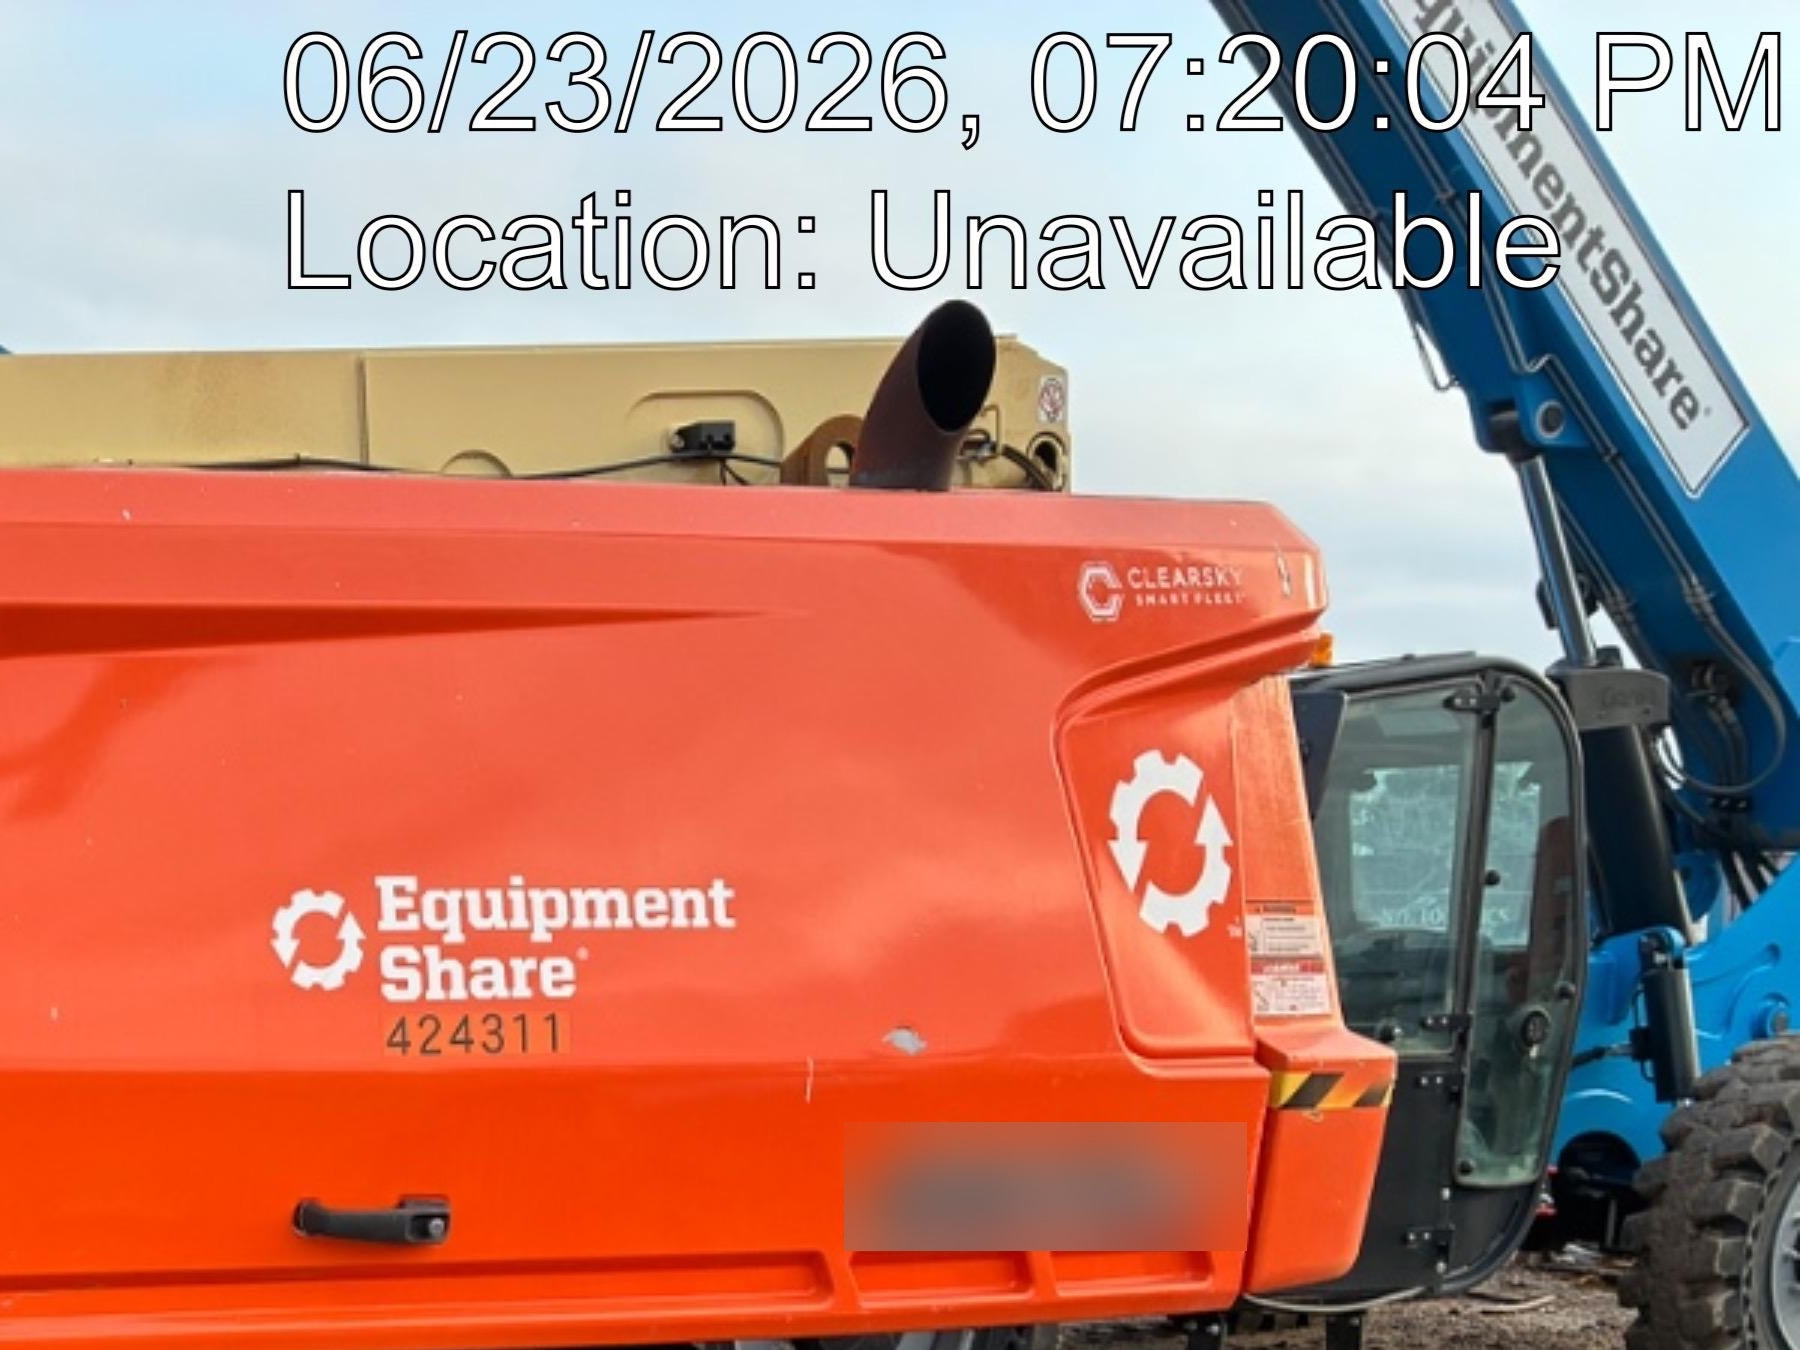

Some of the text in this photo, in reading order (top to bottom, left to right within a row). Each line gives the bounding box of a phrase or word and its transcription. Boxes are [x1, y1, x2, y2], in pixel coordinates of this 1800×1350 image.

[1126, 566, 1243, 589] CLEARSKY
[374, 875, 737, 944] Equipment
[379, 944, 577, 1002] Share
[386, 1012, 560, 1055] 424311
